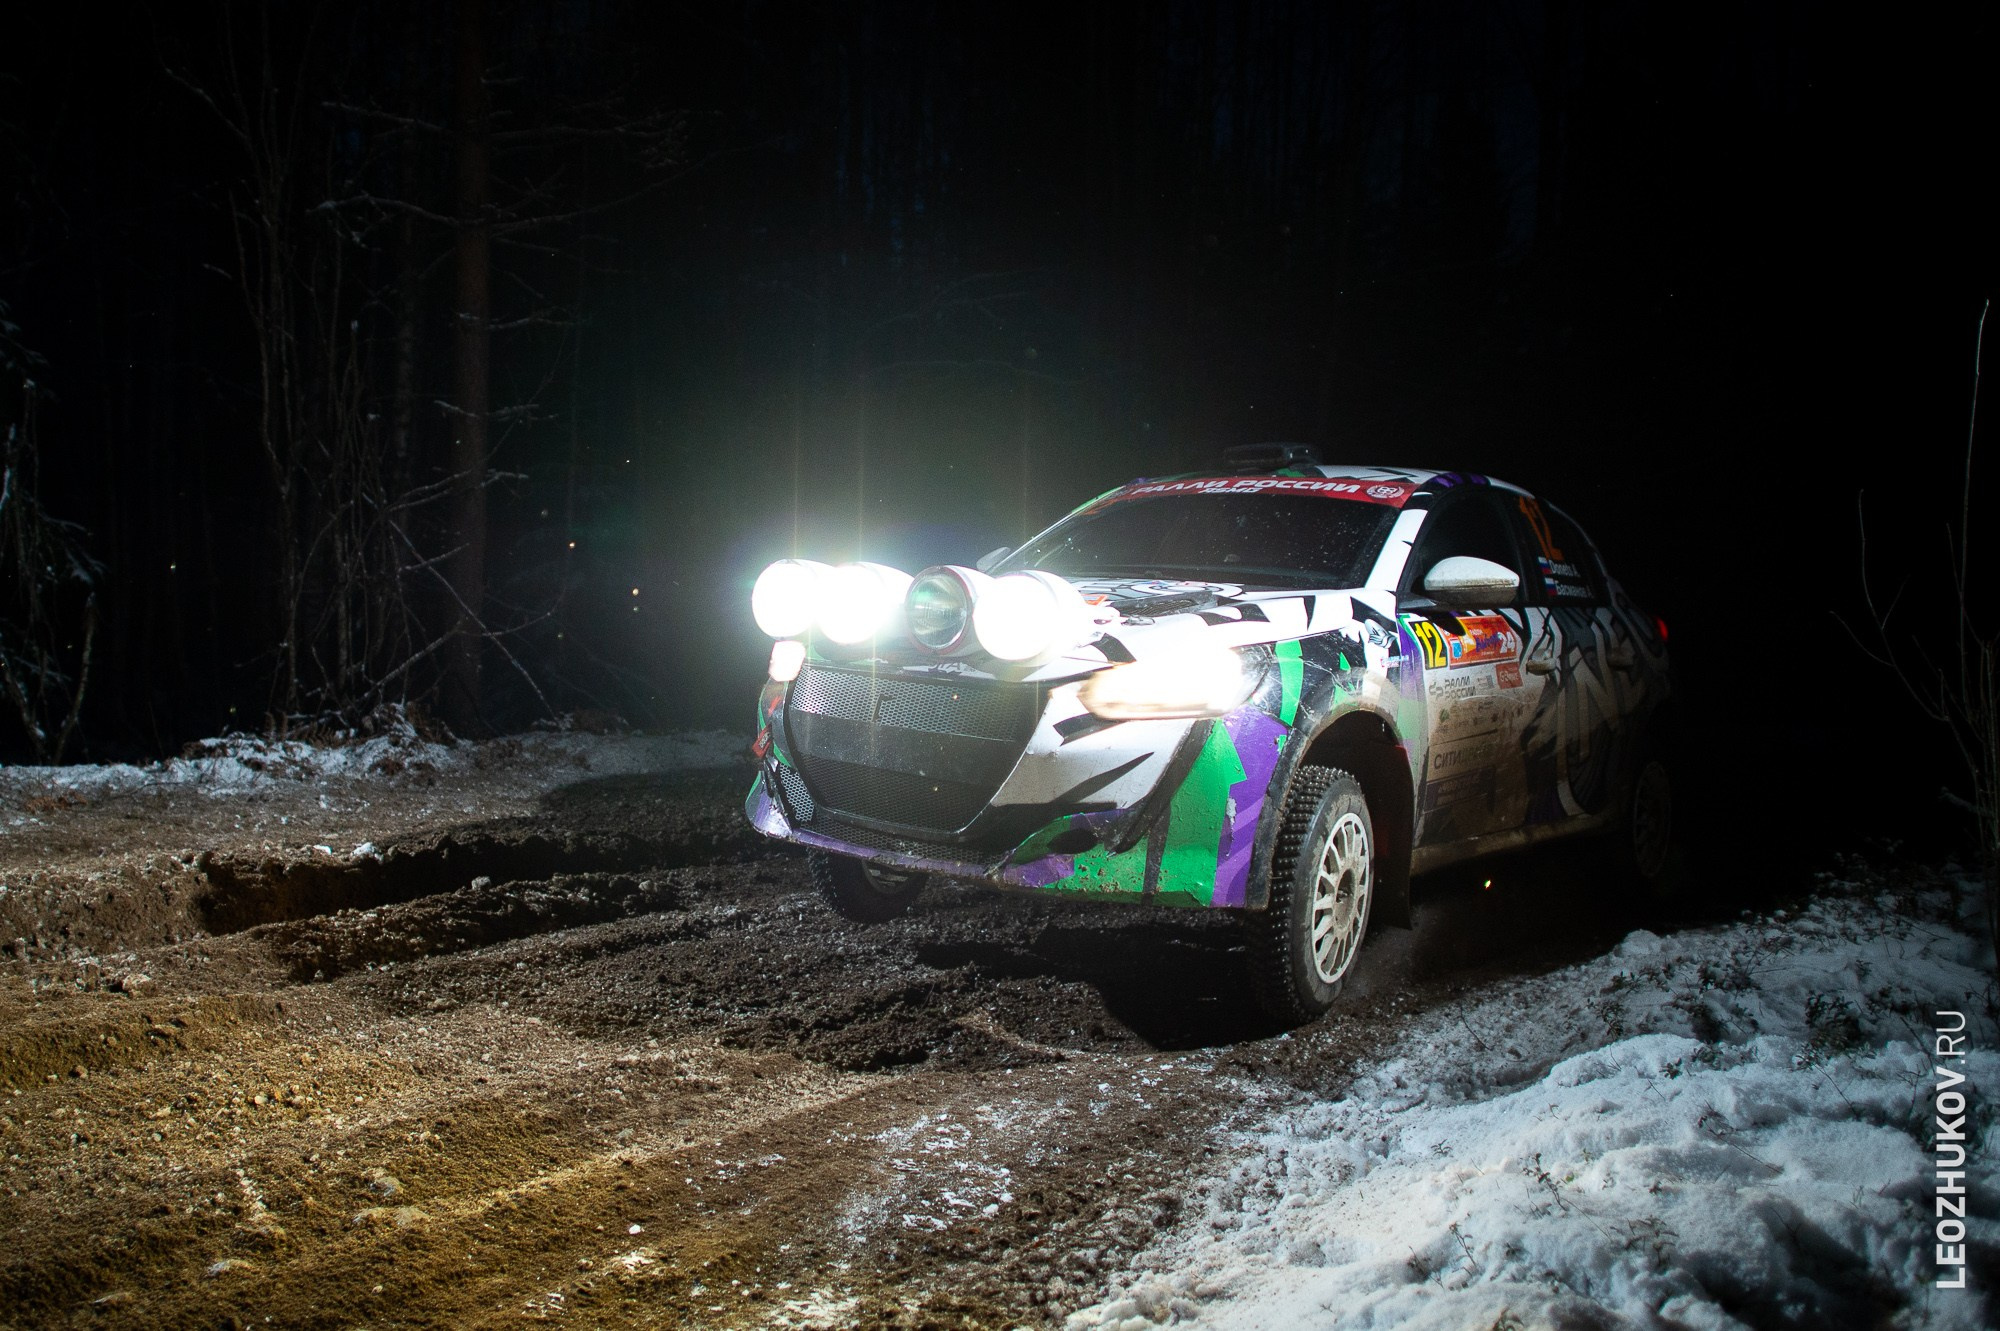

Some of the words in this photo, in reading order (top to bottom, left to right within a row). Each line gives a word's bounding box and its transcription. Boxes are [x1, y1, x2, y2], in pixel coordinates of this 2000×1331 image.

[1131, 480, 1229, 495] РАЛЛИ
[1233, 480, 1361, 493] РОССИИ
[1414, 621, 1447, 668] 12
[1497, 631, 1515, 654] 24
[1444, 675, 1472, 689] РАЛЛИ
[1444, 686, 1477, 700] РОССИИ
